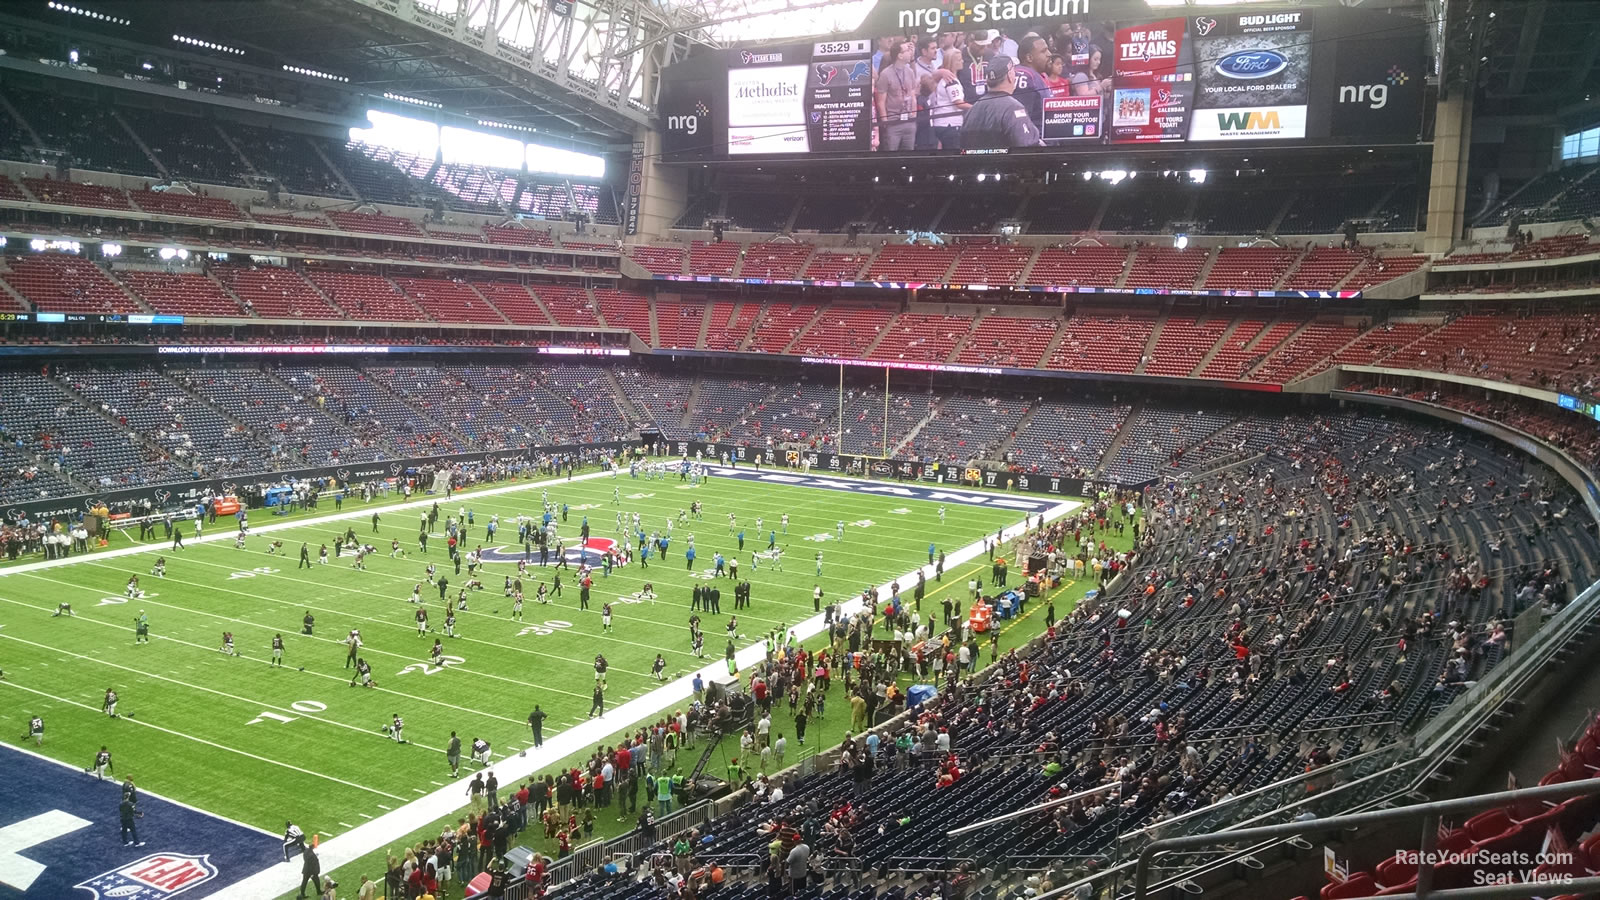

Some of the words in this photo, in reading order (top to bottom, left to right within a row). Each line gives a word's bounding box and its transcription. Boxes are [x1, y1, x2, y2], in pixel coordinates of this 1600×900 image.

[899, 7, 940, 33] nrg
[973, 0, 1089, 22] stadium
[1239, 16, 1265, 26] BUD
[1265, 13, 1301, 24] LIGHT
[1130, 31, 1146, 42] WE
[1147, 30, 1168, 40] ARE
[820, 43, 850, 53] 35:29
[1120, 40, 1177, 58] TEXANS
[1231, 55, 1269, 71] Ford
[735, 82, 798, 98] Methodist
[1339, 84, 1388, 109] nrg
[1045, 99, 1099, 108] #TEXANSSALUTE
[668, 115, 697, 135] nrg
[1217, 111, 1281, 131] WM
[830, 459, 840, 467] 99
[355, 469, 385, 477] TEXANS
[34, 507, 78, 518] TEXANS
[519, 620, 574, 636] 30
[254, 700, 328, 725] 10
[32, 720, 42, 729] 24
[130, 857, 206, 891] NFL
